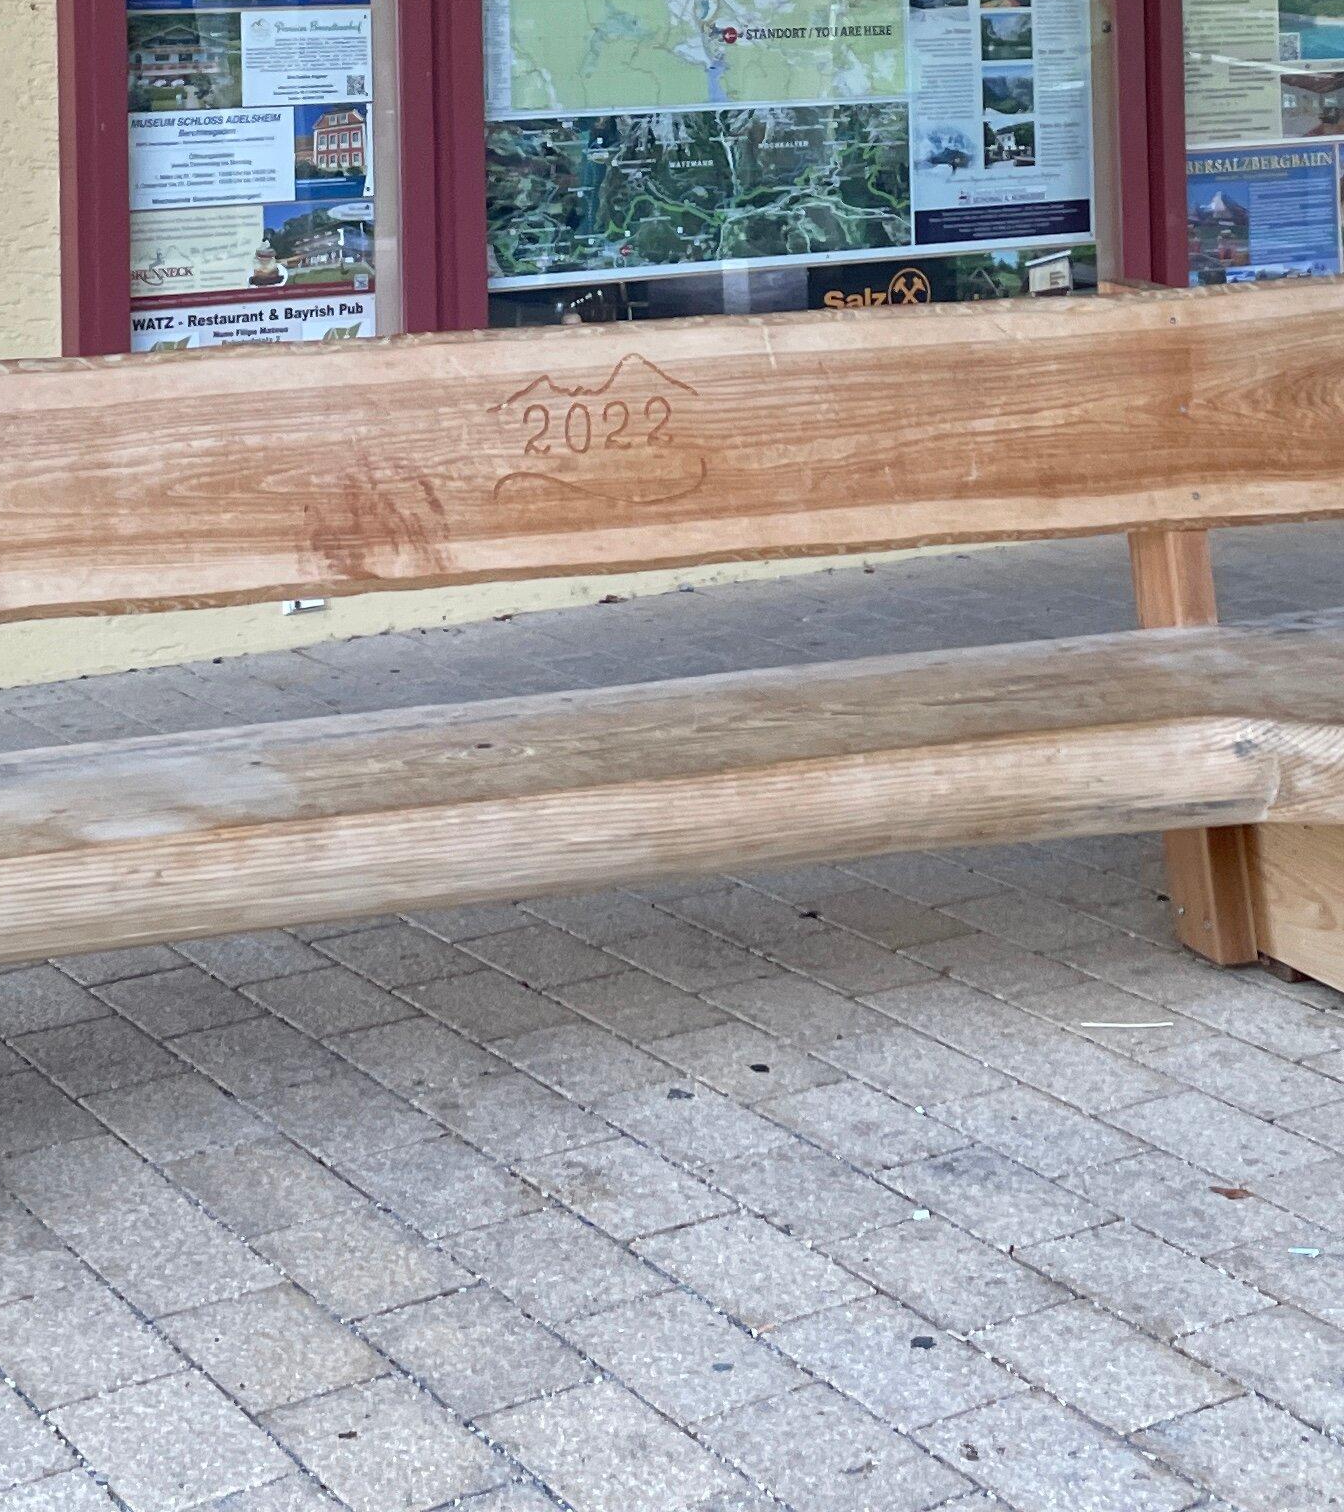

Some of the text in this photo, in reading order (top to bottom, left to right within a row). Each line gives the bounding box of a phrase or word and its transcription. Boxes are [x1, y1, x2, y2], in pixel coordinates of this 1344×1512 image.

[746, 27, 807, 40] STANDORT
[840, 25, 861, 37] ARE
[863, 24, 893, 37] HERE
[177, 115, 223, 127] SCHLOSS
[1186, 151, 1333, 175] BERSALZBERGBAHN
[132, 316, 174, 331] WATZ
[187, 312, 264, 328] Restaurant
[269, 309, 279, 320] &
[284, 306, 335, 321] Bayrish
[339, 302, 364, 315] Pub
[523, 396, 674, 455] 2022
